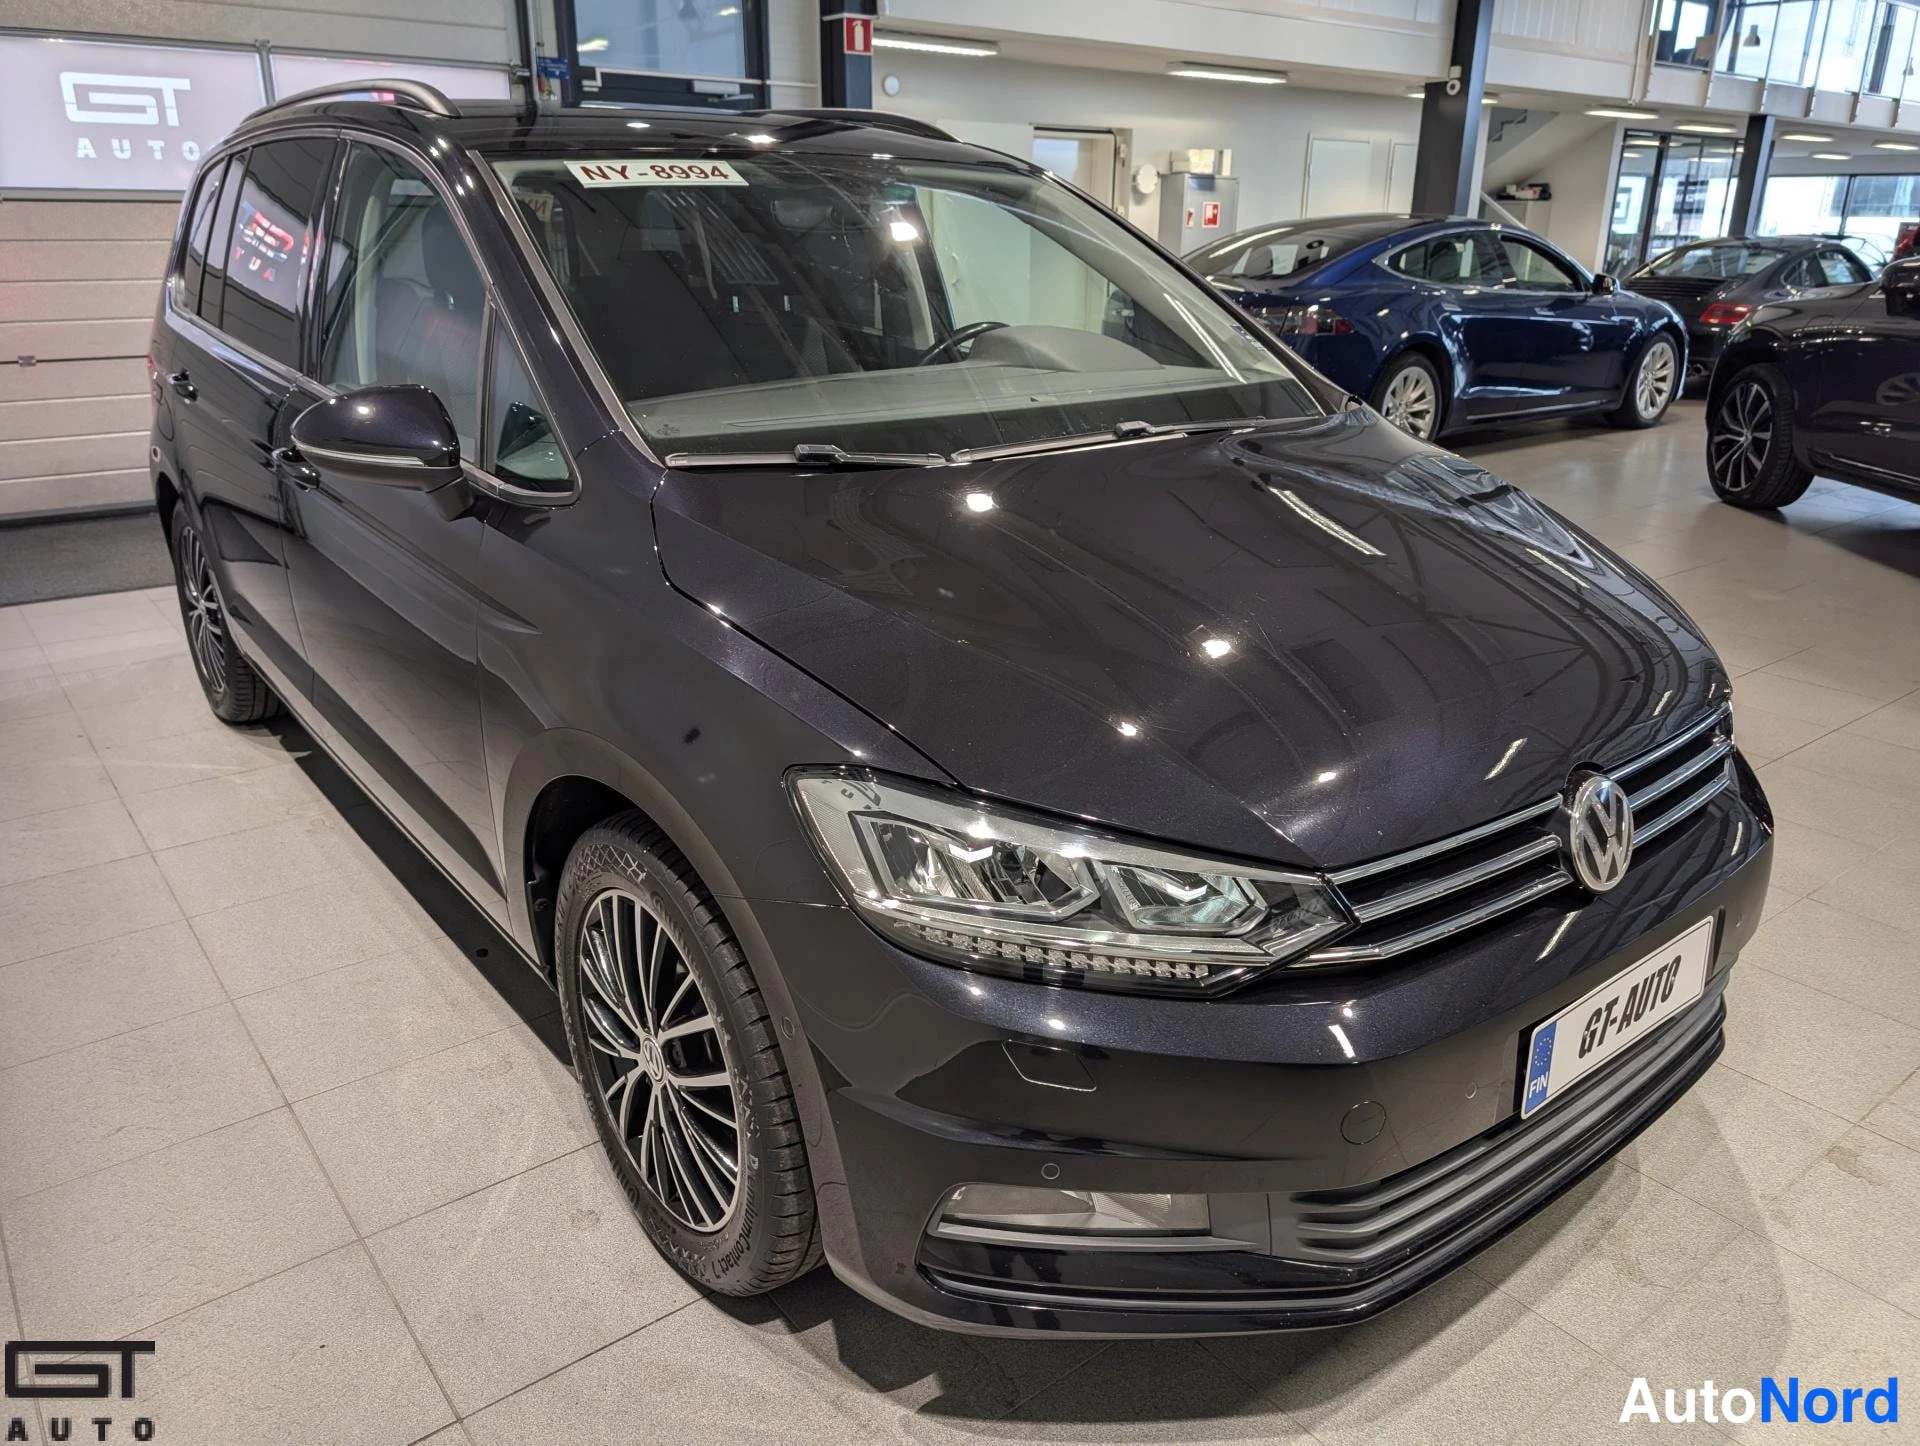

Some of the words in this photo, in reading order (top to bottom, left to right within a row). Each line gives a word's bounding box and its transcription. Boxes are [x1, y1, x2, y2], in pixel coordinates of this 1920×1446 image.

[60, 72, 191, 127] GT
[77, 137, 201, 161] AUTO
[580, 164, 729, 181] NY-8994
[1578, 954, 1682, 1060] GT-AUTO
[1528, 1071, 1549, 1099] FIN
